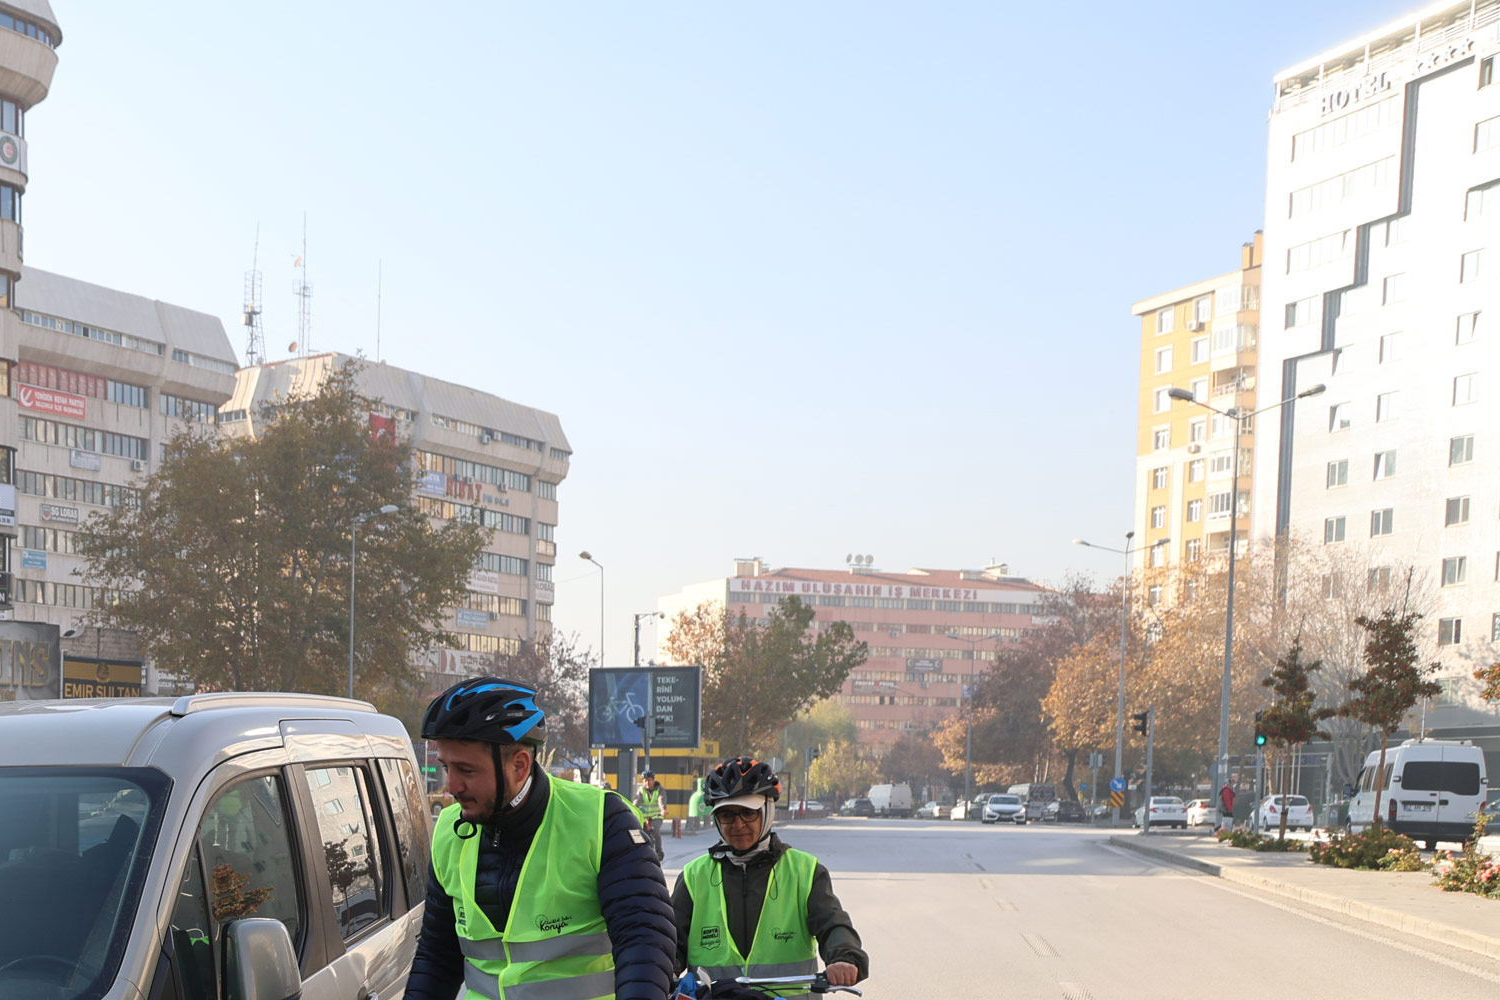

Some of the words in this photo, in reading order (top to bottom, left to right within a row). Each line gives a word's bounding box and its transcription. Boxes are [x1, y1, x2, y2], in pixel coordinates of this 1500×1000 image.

[1321, 72, 1392, 117] HOTEL
[535, 581, 554, 592] LOBAL
[741, 579, 795, 592] HAZIM
[656, 705, 673, 713] DAN
[540, 920, 569, 933] Konya
